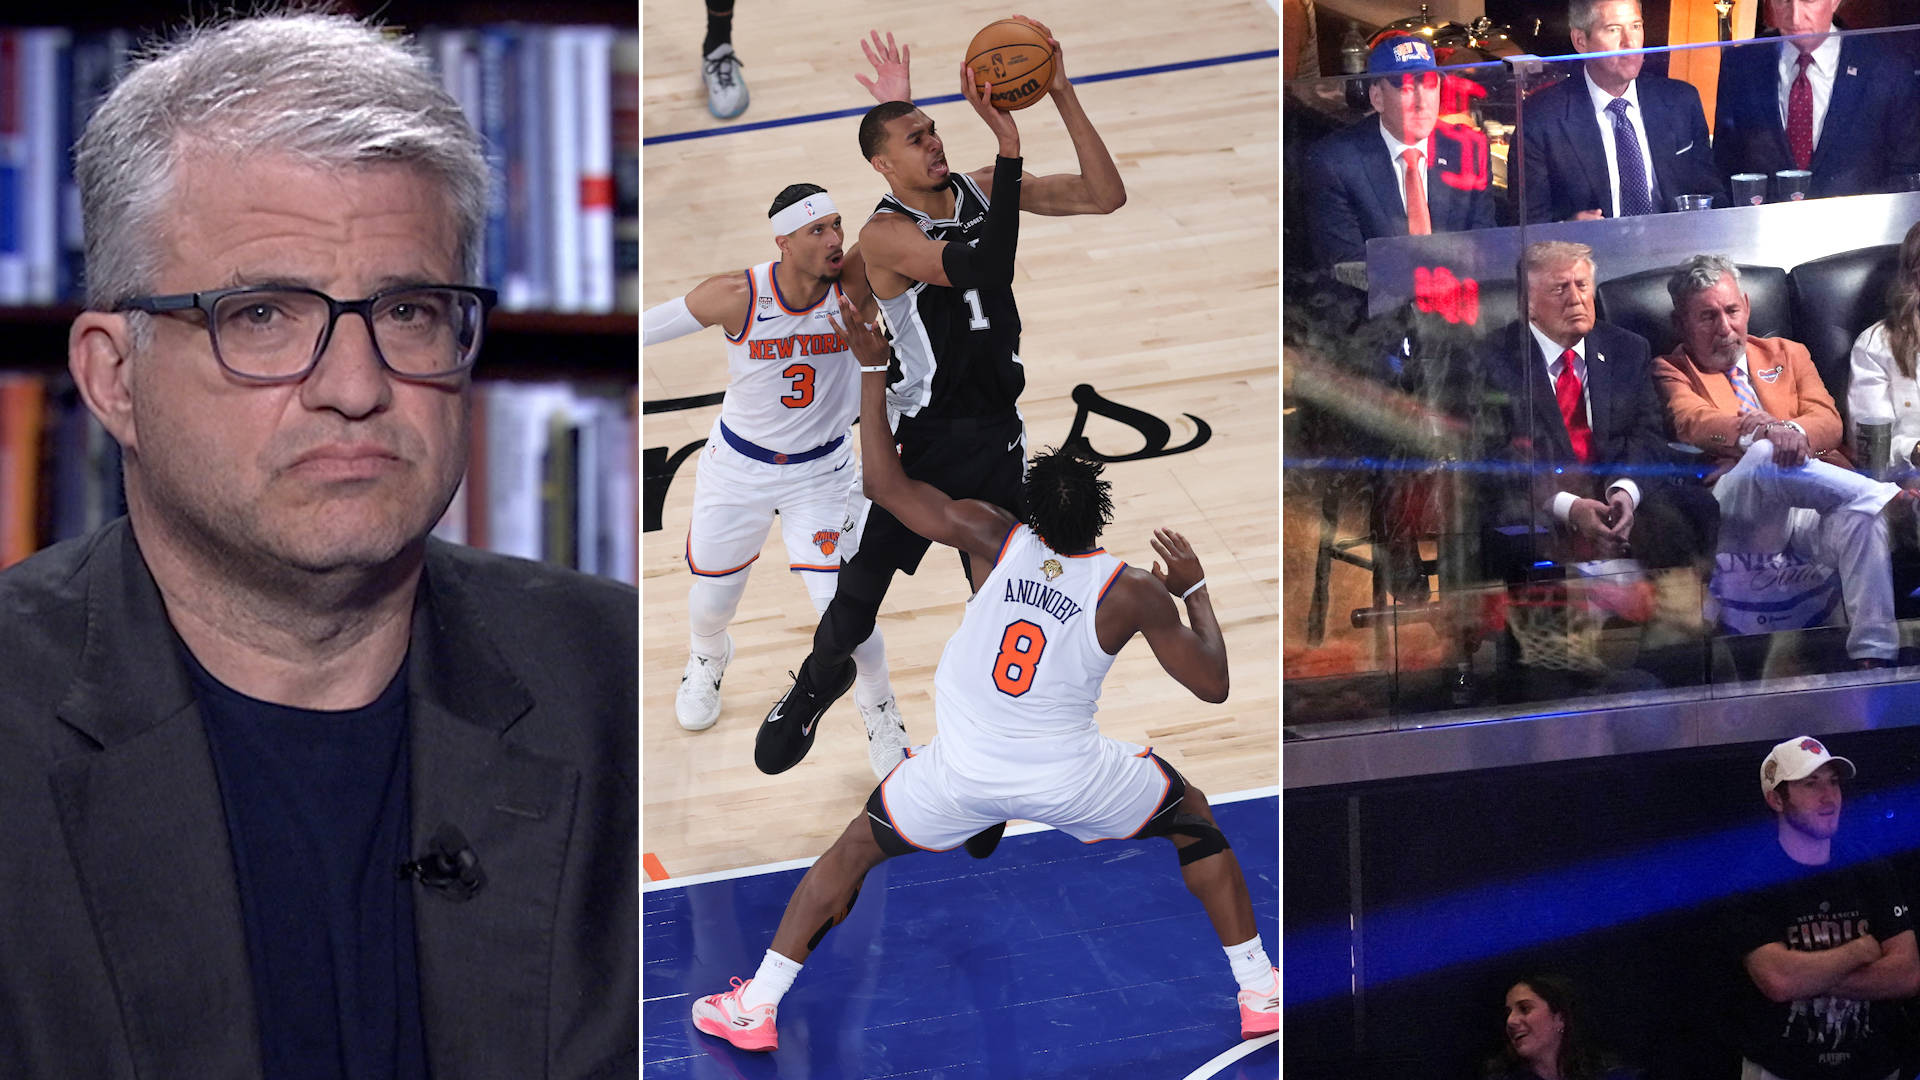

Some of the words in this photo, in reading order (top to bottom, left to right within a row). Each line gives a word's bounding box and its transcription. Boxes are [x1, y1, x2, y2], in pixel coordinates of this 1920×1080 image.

[963, 215, 984, 229] LEDGER
[963, 288, 991, 331] 1
[748, 336, 795, 360] NEW
[780, 363, 816, 409] 3
[1004, 578, 1083, 625] ANUNOBY
[992, 618, 1048, 698] 8
